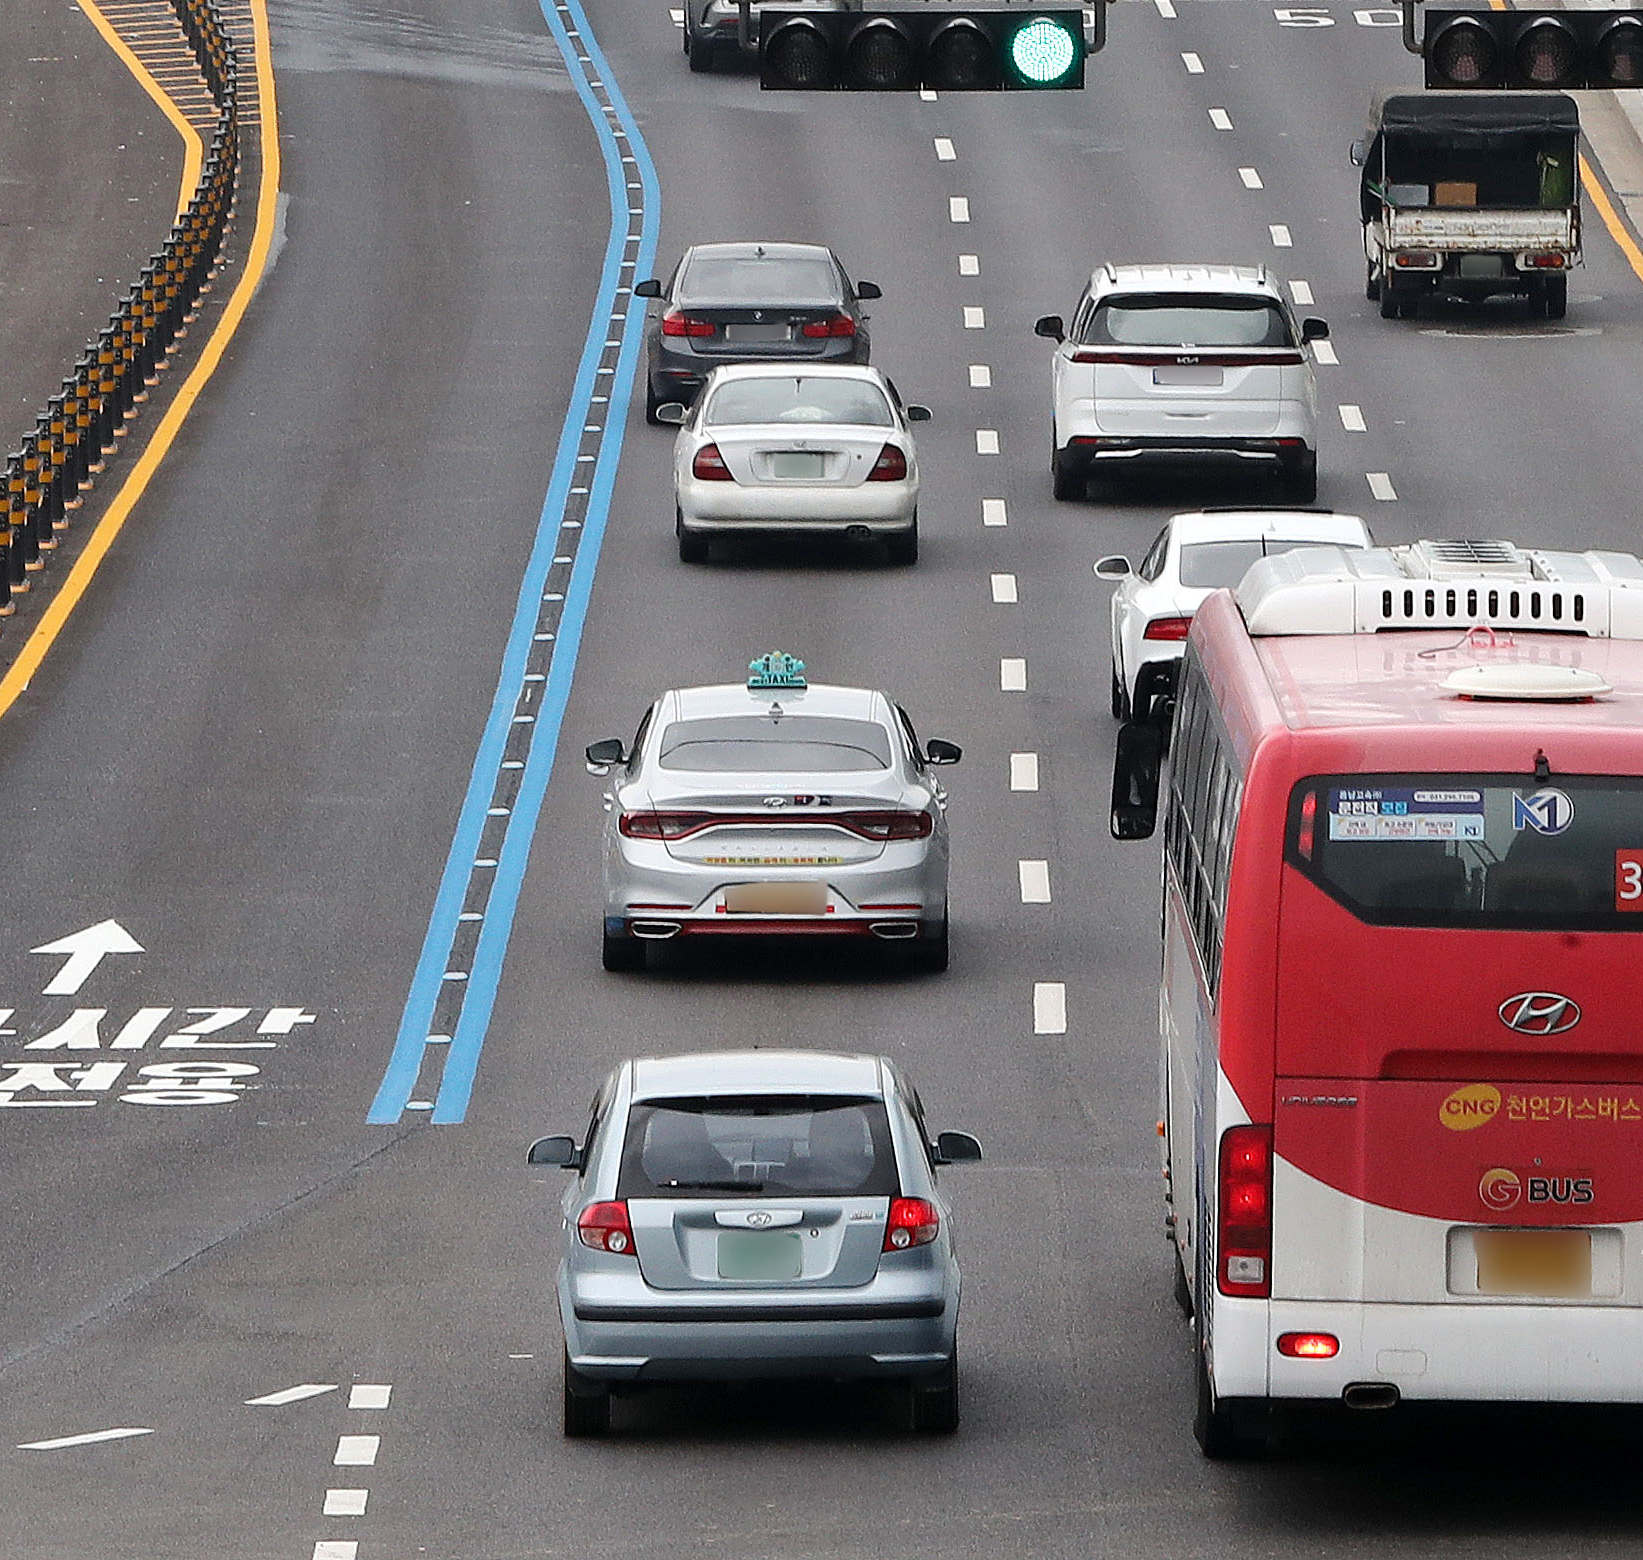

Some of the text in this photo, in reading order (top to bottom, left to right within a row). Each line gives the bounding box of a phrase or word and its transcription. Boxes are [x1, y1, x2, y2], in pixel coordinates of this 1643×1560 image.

[1445, 1099, 1497, 1115] CNG
[1507, 1095, 1642, 1121] 천연가스버스
[1528, 1178, 1594, 1203] BUS
